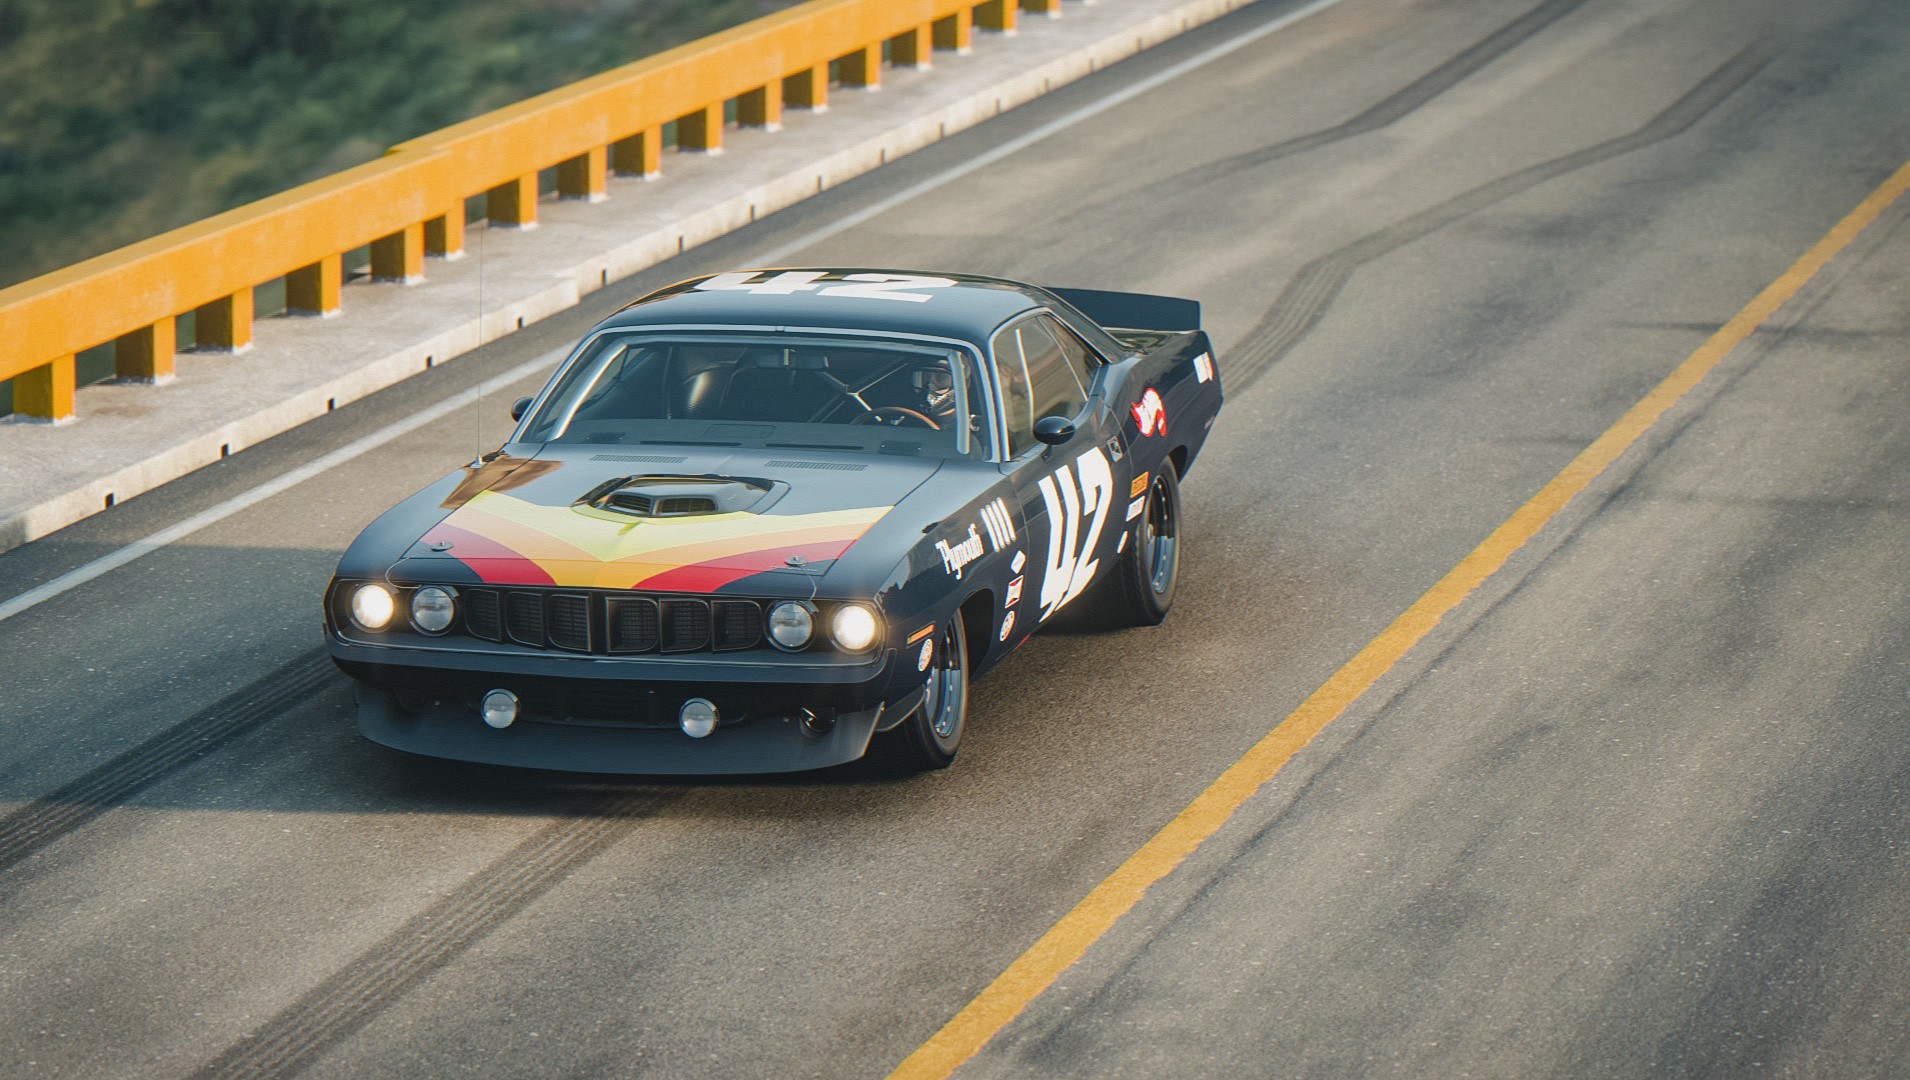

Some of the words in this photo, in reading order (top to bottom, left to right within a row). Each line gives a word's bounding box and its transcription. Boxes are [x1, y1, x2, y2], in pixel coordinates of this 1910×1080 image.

[693, 271, 959, 303] 42
[935, 522, 984, 580] Plymouth
[1038, 446, 1113, 622] 42
